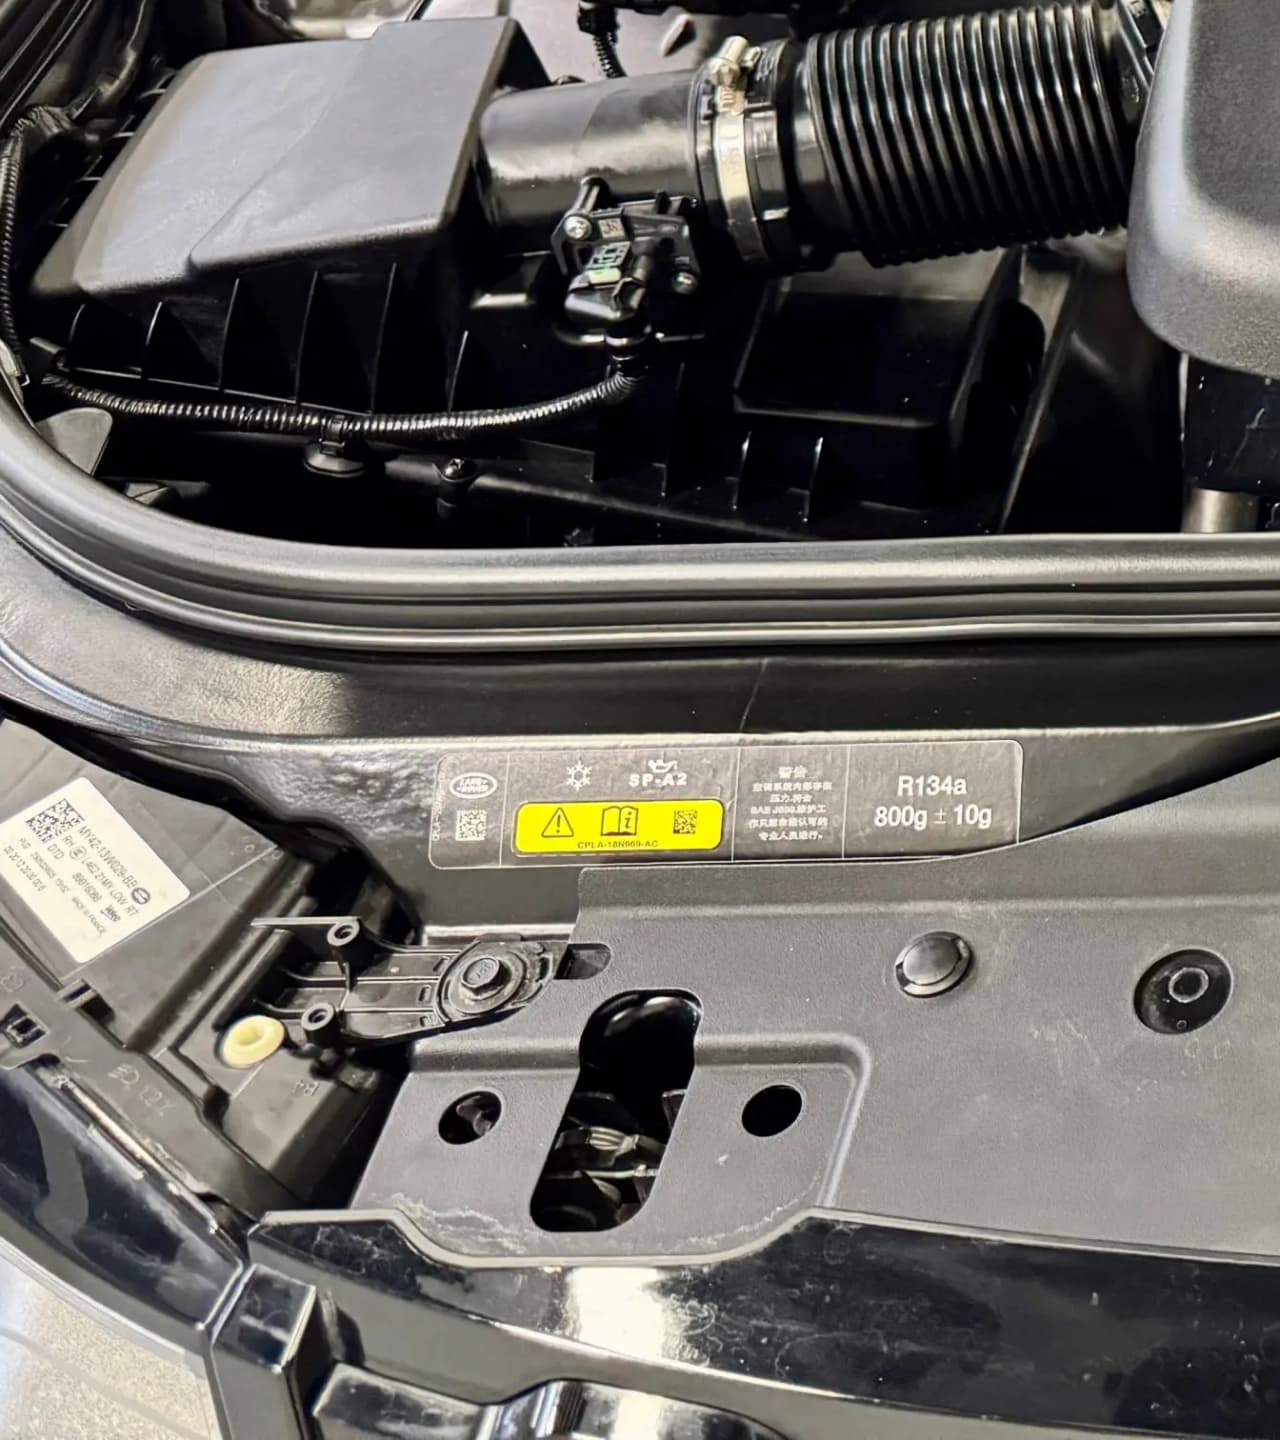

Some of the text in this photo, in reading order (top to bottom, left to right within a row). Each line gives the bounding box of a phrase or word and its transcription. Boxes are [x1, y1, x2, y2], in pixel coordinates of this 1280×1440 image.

[629, 772, 688, 787] SP-A2
[897, 775, 967, 796] R134a
[874, 803, 992, 832] 800g ± 10g
